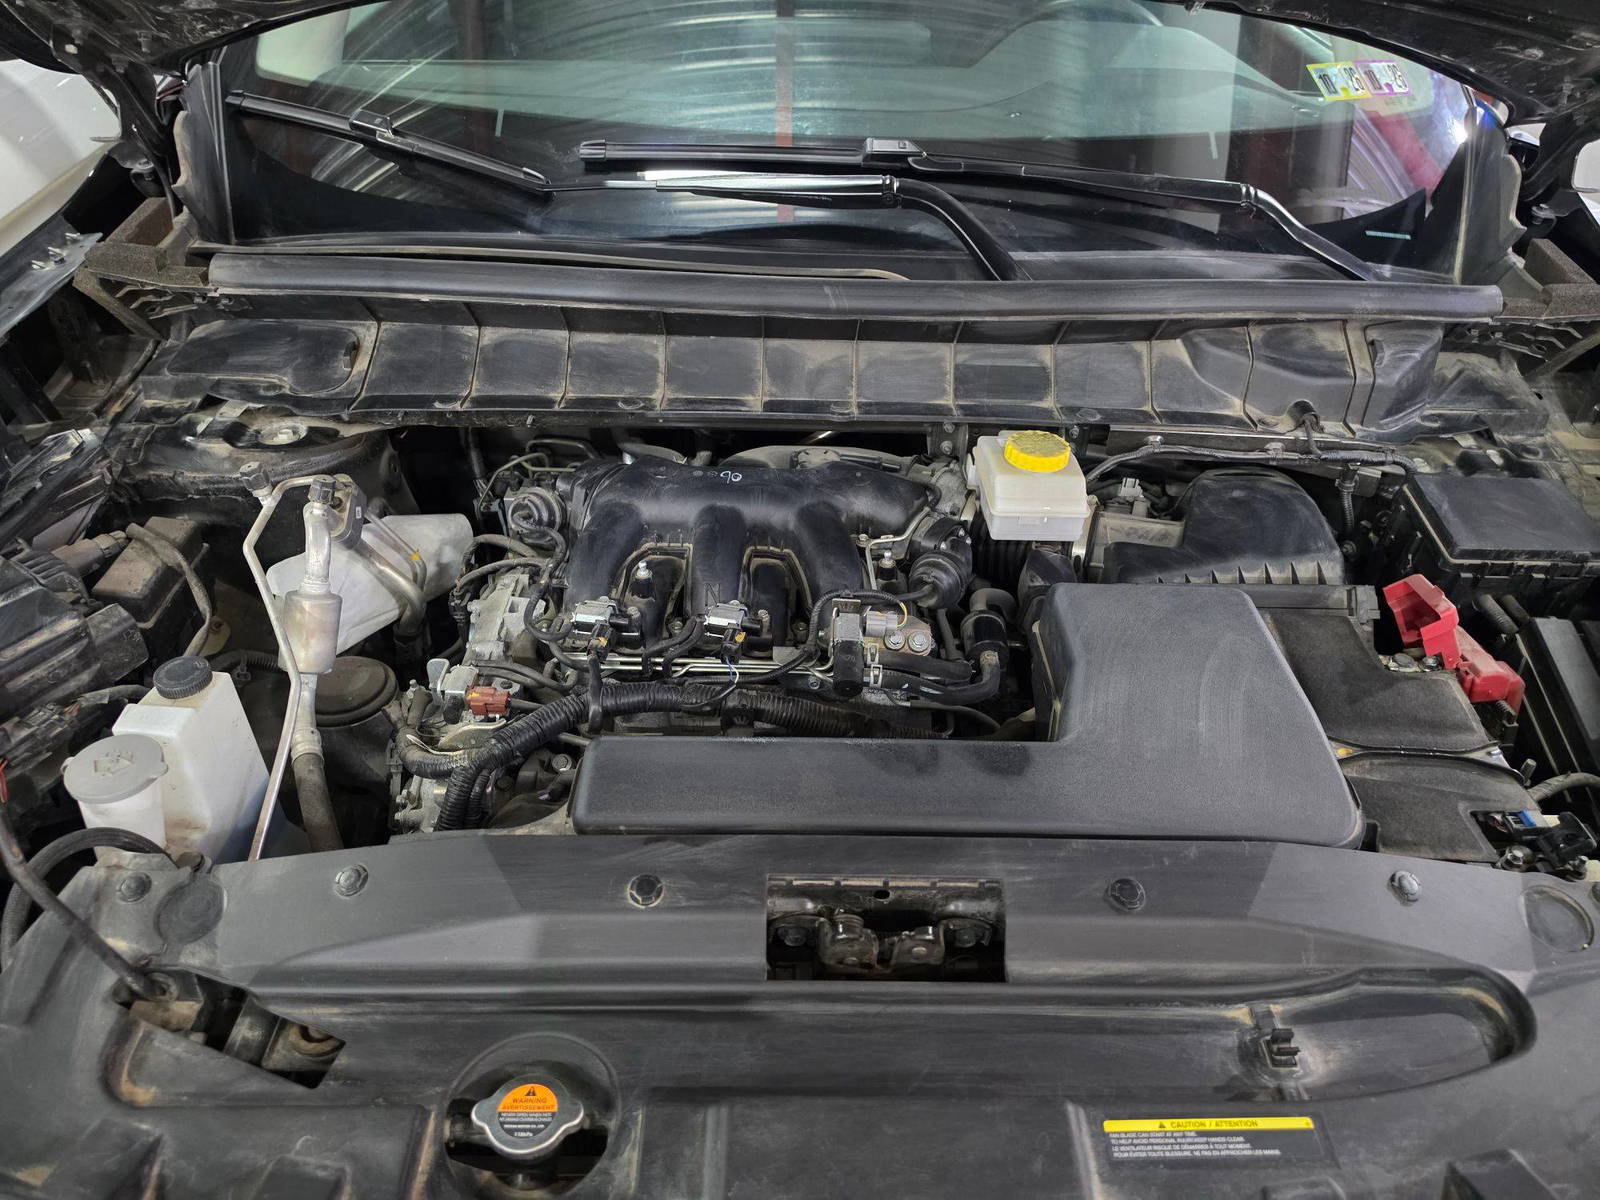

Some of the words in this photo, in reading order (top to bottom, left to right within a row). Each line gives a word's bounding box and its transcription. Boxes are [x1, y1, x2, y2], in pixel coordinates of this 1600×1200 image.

[1318, 73, 1338, 95] 10
[720, 470, 742, 484] 90
[512, 1096, 547, 1104] WARNING
[1170, 1121, 1206, 1129] CAUTION
[1215, 1120, 1258, 1128] ATTENTION
